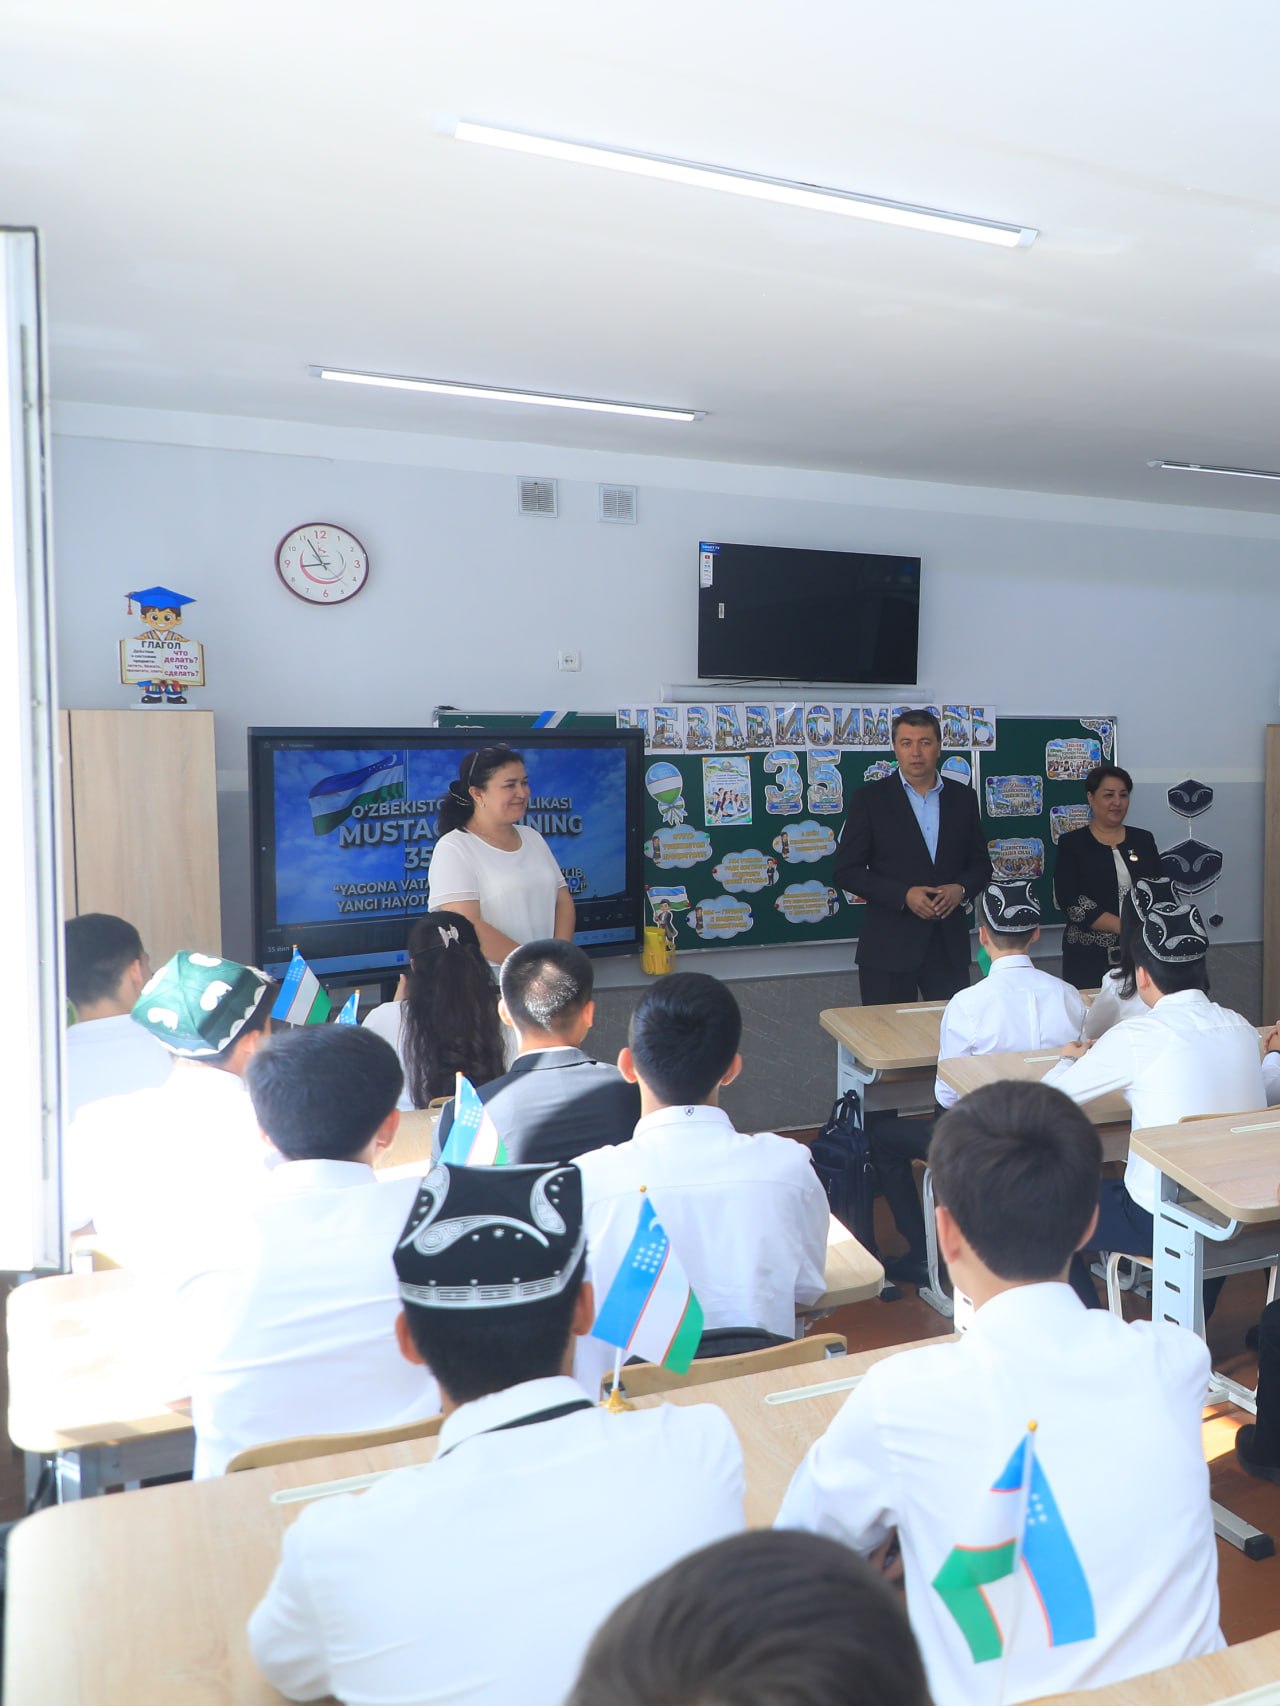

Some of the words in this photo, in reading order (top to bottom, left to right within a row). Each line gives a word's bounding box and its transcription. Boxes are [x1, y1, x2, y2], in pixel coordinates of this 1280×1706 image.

[314, 530, 327, 539] 12
[284, 559, 291, 568] 9
[354, 559, 361, 568] 3
[323, 589, 329, 598] 6
[141, 641, 181, 650] ГЛАГОЛ
[164, 657, 199, 665] делать?
[618, 704, 995, 751] НЕЗАВИСИМТЬ
[763, 749, 843, 816] 35
[404, 846, 433, 870] 35
[337, 898, 378, 913] YANGI
